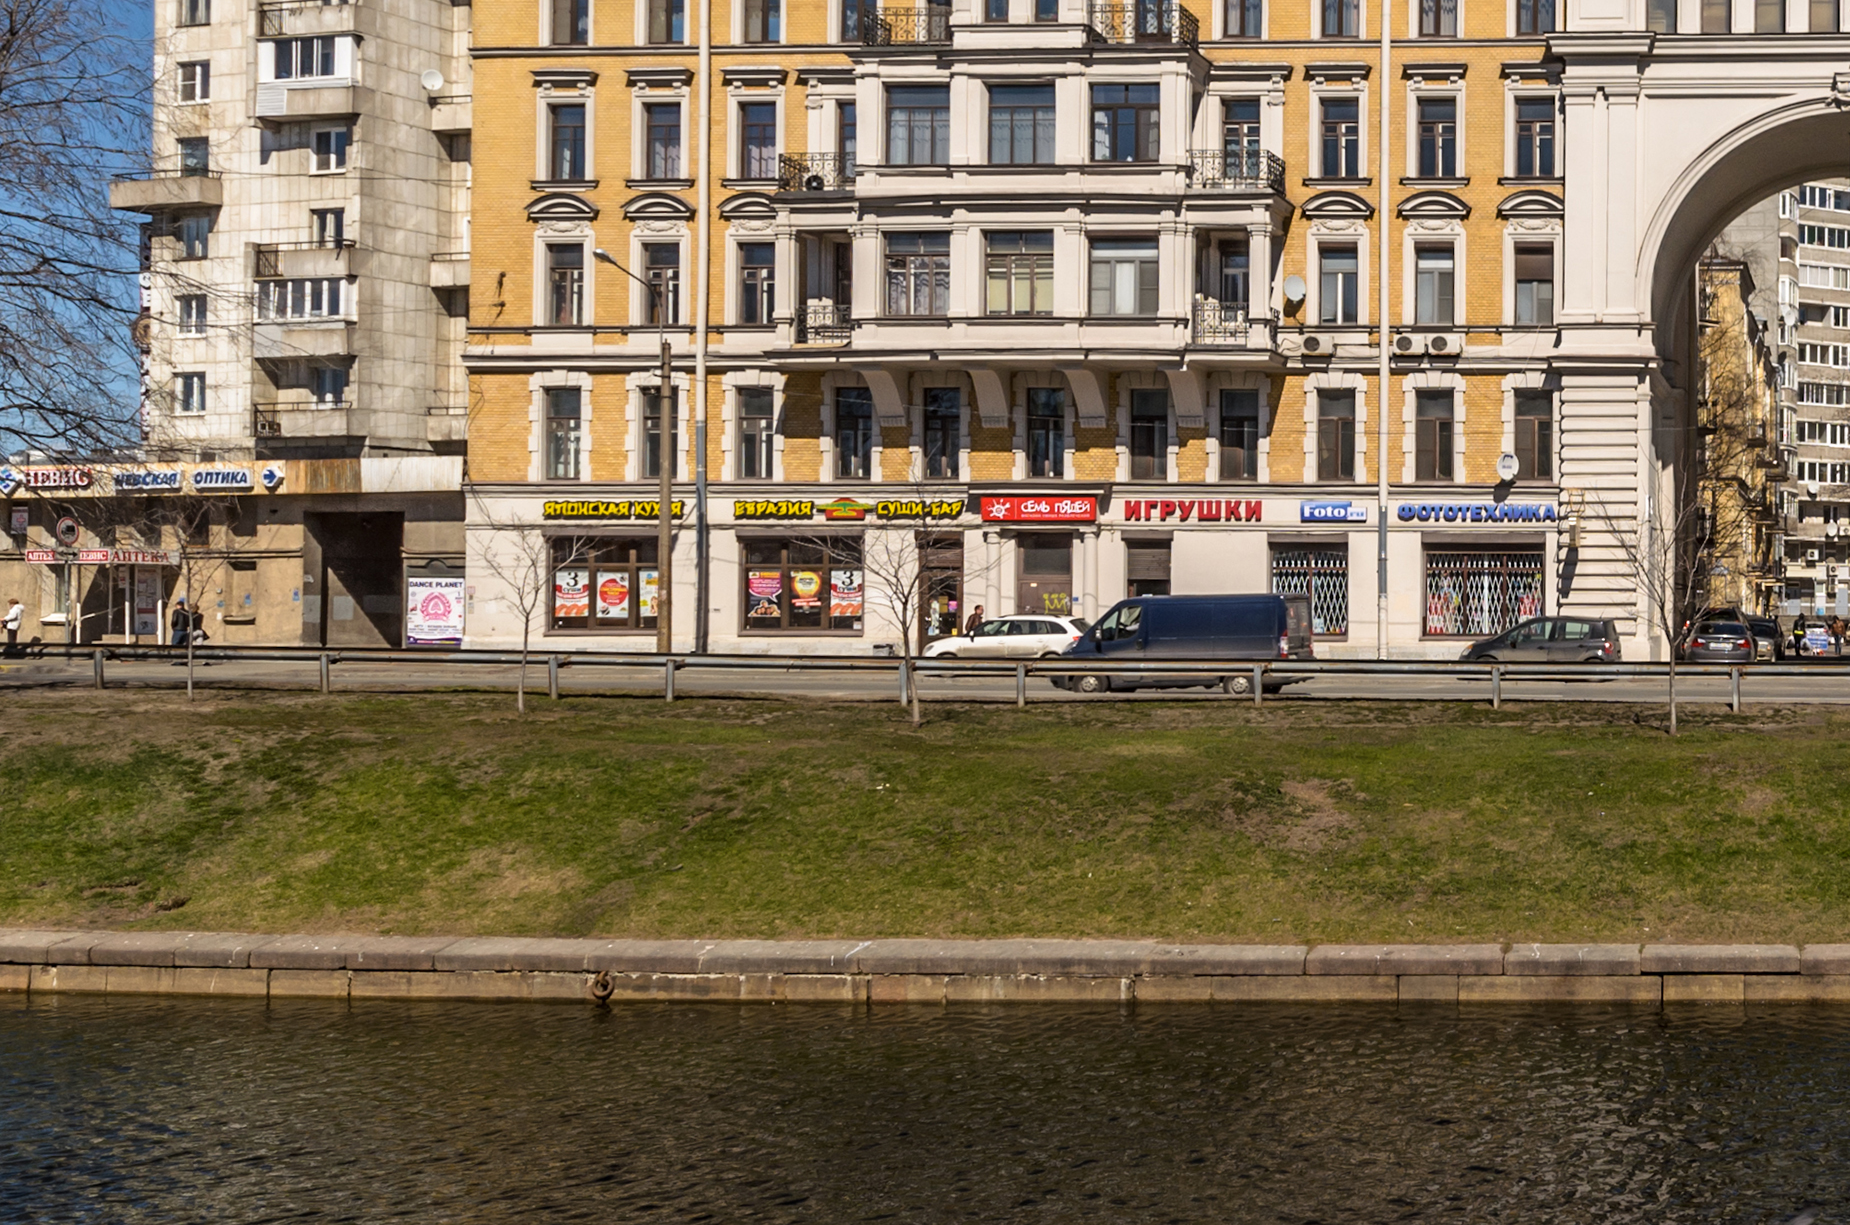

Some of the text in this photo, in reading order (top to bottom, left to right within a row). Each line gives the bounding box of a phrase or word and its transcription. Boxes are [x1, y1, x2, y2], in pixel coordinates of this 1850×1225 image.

[194, 471, 248, 485] ОПТИКА
[544, 501, 683, 516] ЯПОНСКАЯ КУХЯ
[734, 500, 963, 516] ЕВРАЗИЯ СУШИ-БАР
[1021, 500, 1090, 513] СЕМЬ ПЯДЕЙ
[1124, 500, 1262, 521] ИГРУШКИ
[1397, 503, 1557, 522] ФОТОТЕХНИКА
[112, 551, 169, 563] АПТЕКА
[566, 571, 579, 588] 3
[842, 570, 854, 586] 3
